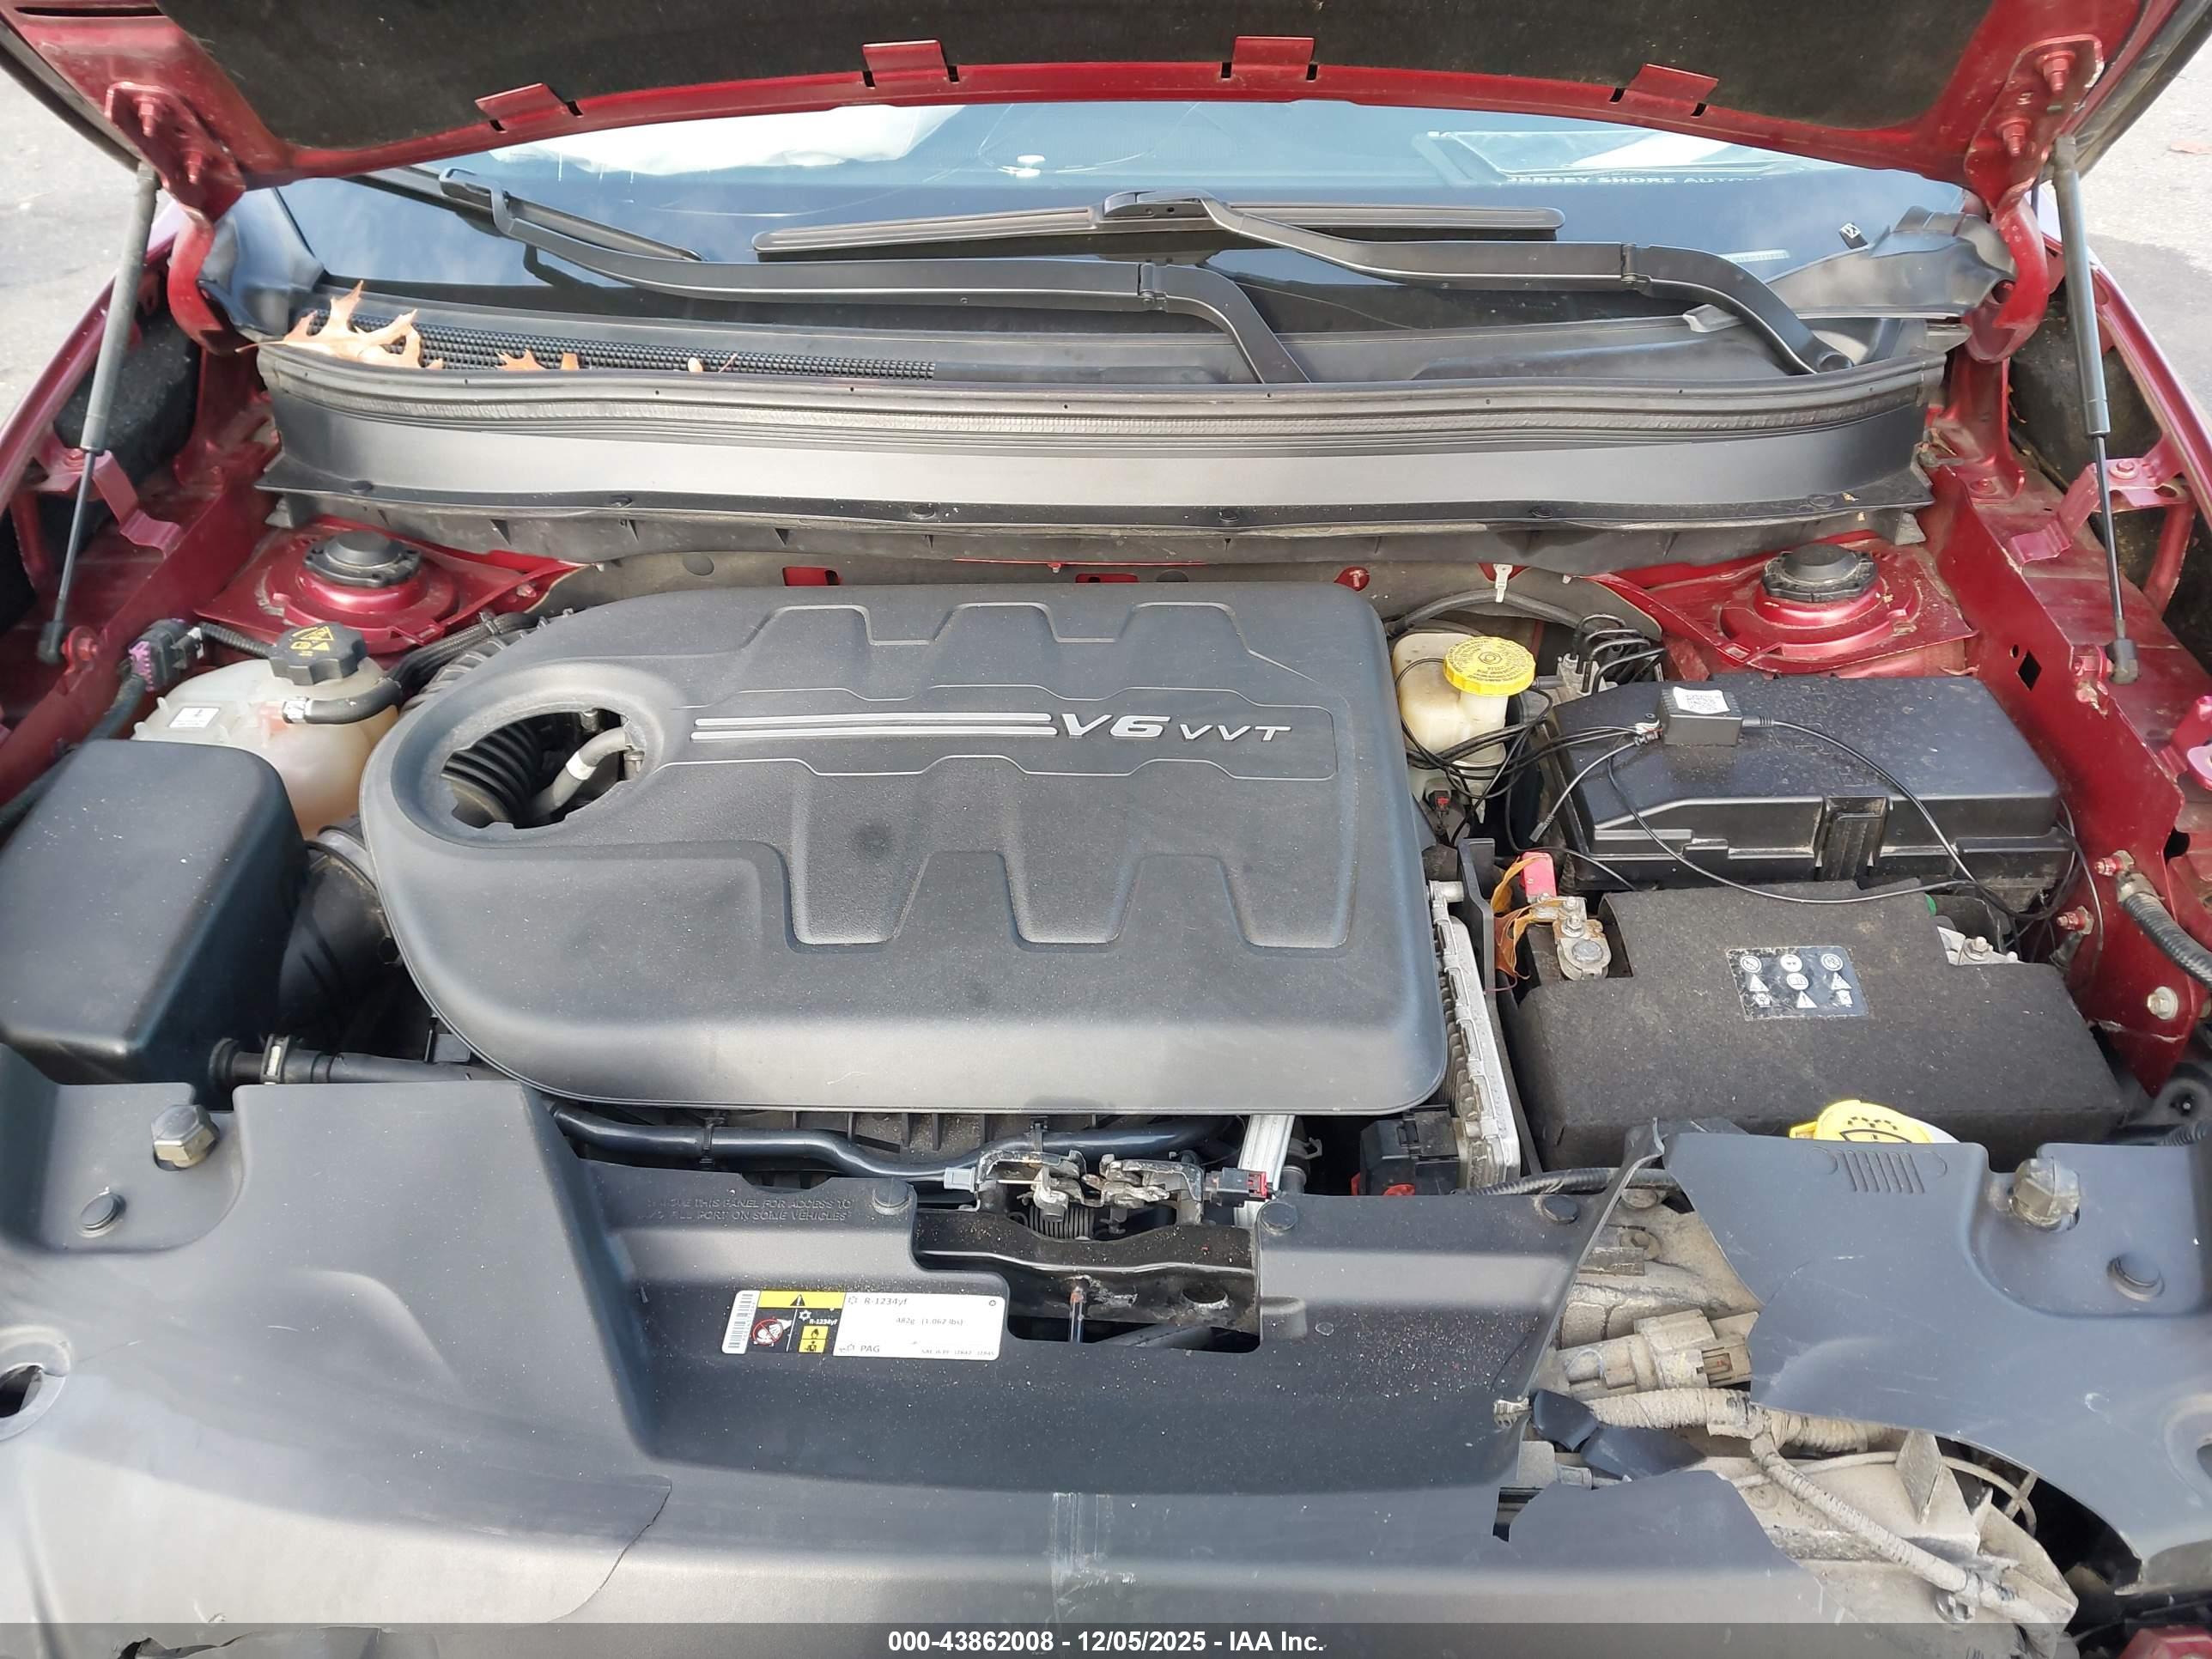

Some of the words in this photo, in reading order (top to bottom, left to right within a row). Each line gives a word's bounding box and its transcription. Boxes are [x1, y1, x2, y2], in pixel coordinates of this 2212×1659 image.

[1061, 713, 1171, 737] V6
[1179, 724, 1291, 741] VVT
[695, 1199, 720, 1208] THIS
[762, 1199, 786, 1209] FOR
[836, 1199, 851, 1209] TO
[732, 1210, 750, 1219] ON
[863, 1297, 908, 1306] R-1234yf
